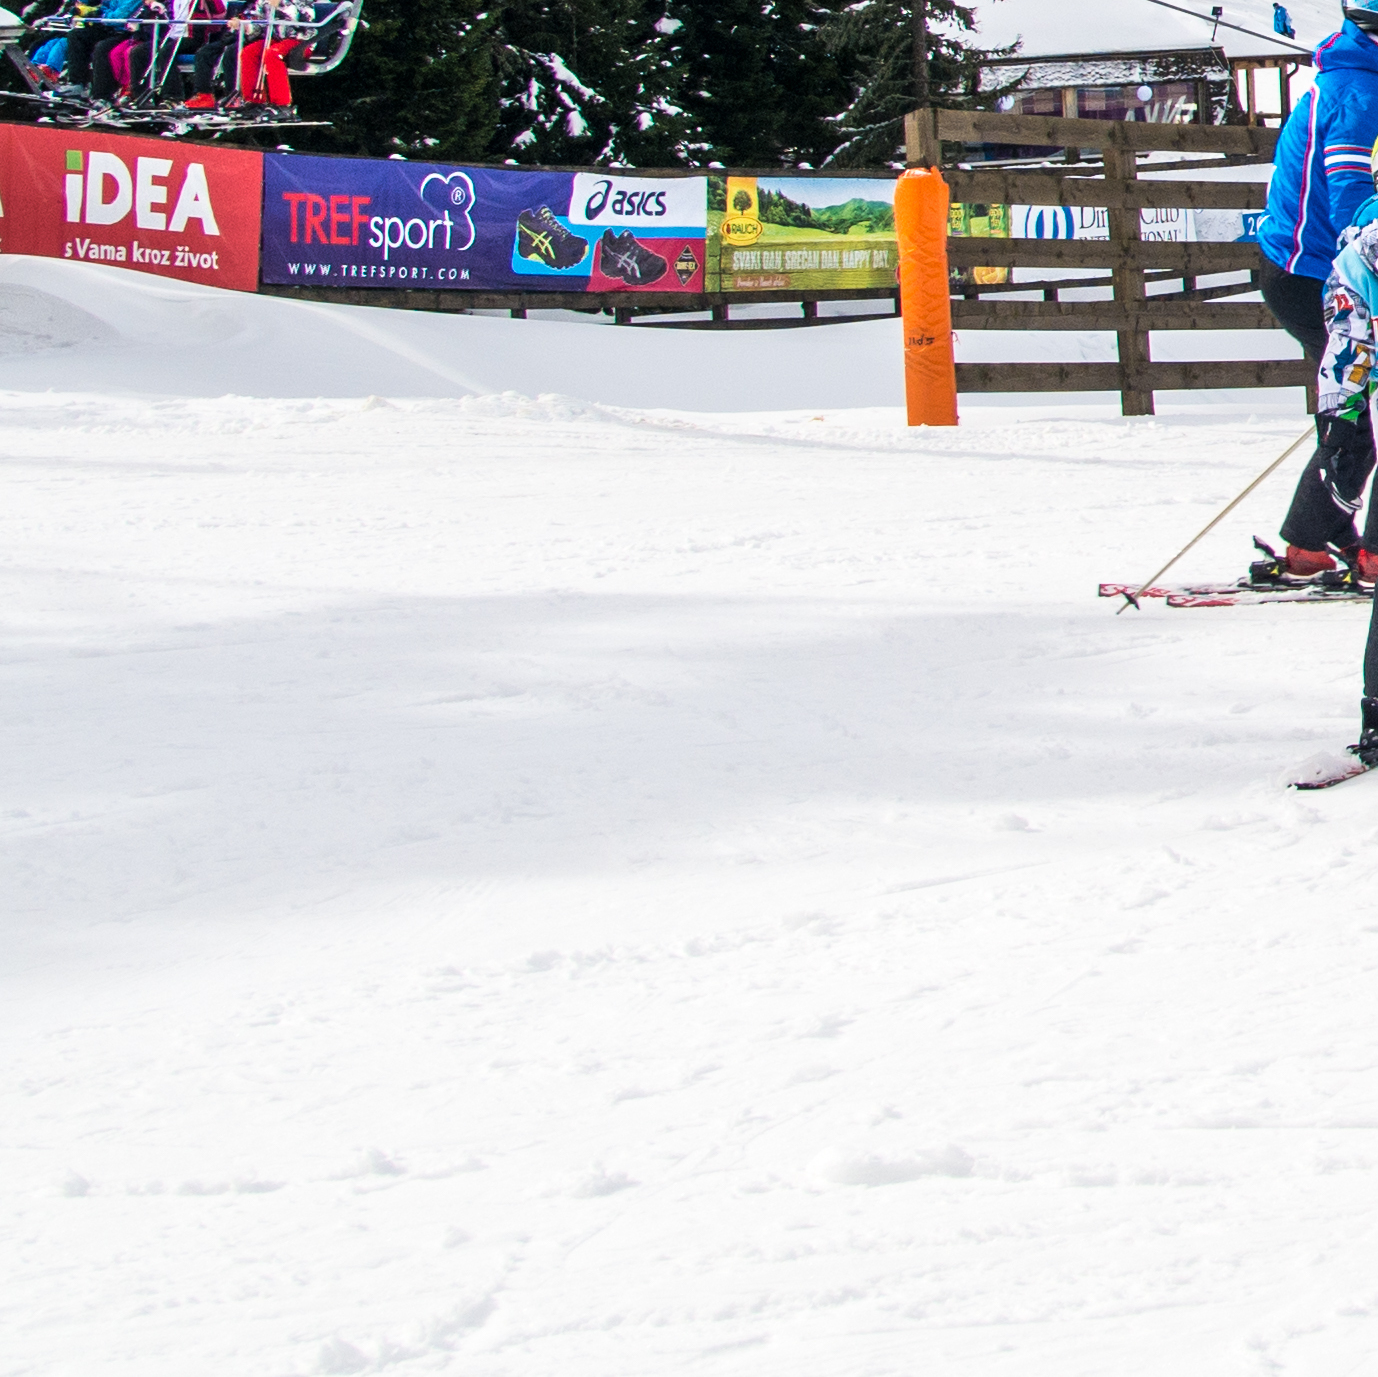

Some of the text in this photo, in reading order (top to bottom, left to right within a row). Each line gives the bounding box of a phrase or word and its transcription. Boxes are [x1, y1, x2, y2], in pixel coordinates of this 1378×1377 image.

[612, 190, 667, 216] asics
[730, 223, 758, 234] RAUCH
[65, 238, 219, 270] s Vama kroz život
[288, 263, 470, 280] WWW.TREFSPORT.COM
